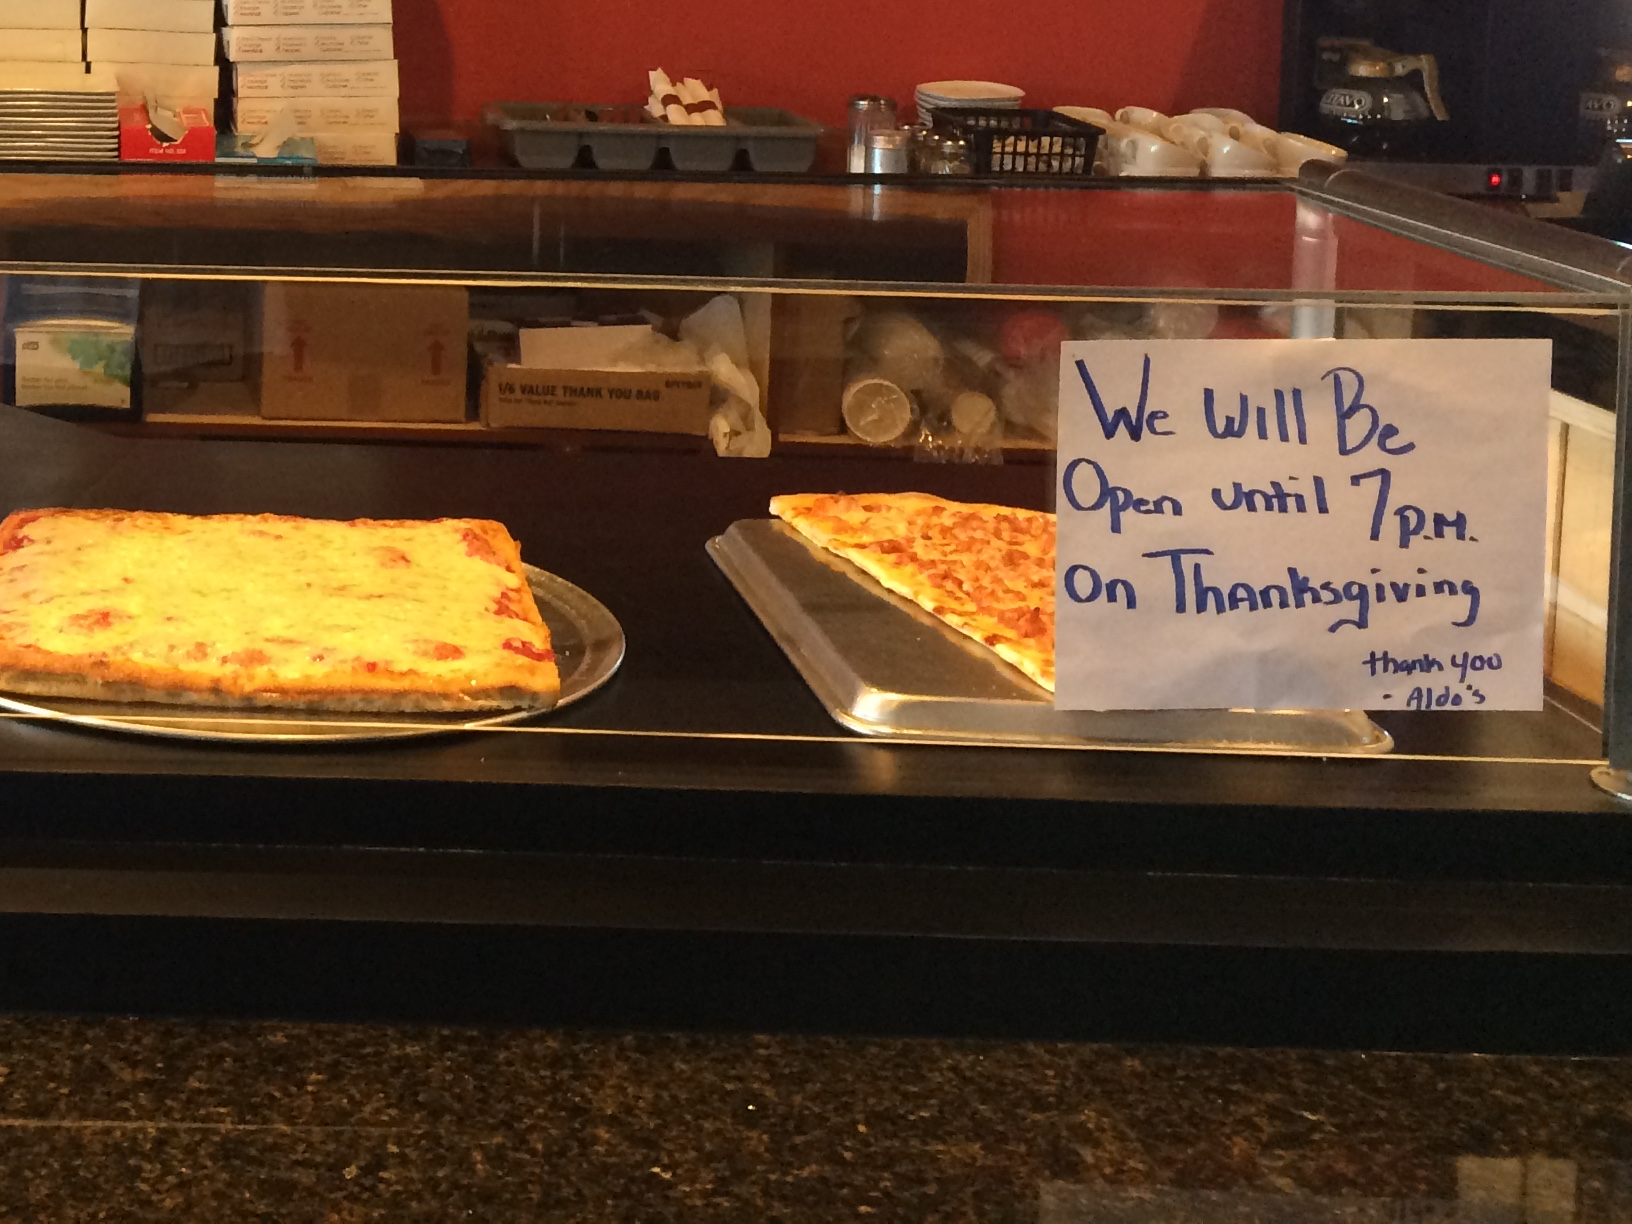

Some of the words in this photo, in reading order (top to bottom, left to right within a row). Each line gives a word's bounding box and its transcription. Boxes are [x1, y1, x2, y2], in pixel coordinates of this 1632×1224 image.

[520, 384, 557, 396] VALUE
[563, 385, 603, 398] THANK
[608, 387, 632, 399] YOU
[1074, 353, 1176, 442] We
[1203, 387, 1307, 446] Will
[1321, 365, 1416, 457] Be
[1062, 457, 1183, 534] Open
[1211, 475, 1329, 514] until
[1064, 564, 1137, 610] On
[1142, 548, 1481, 633] Thanksgiving
[1362, 649, 1443, 677] thank
[1406, 683, 1486, 709] Aldo's
